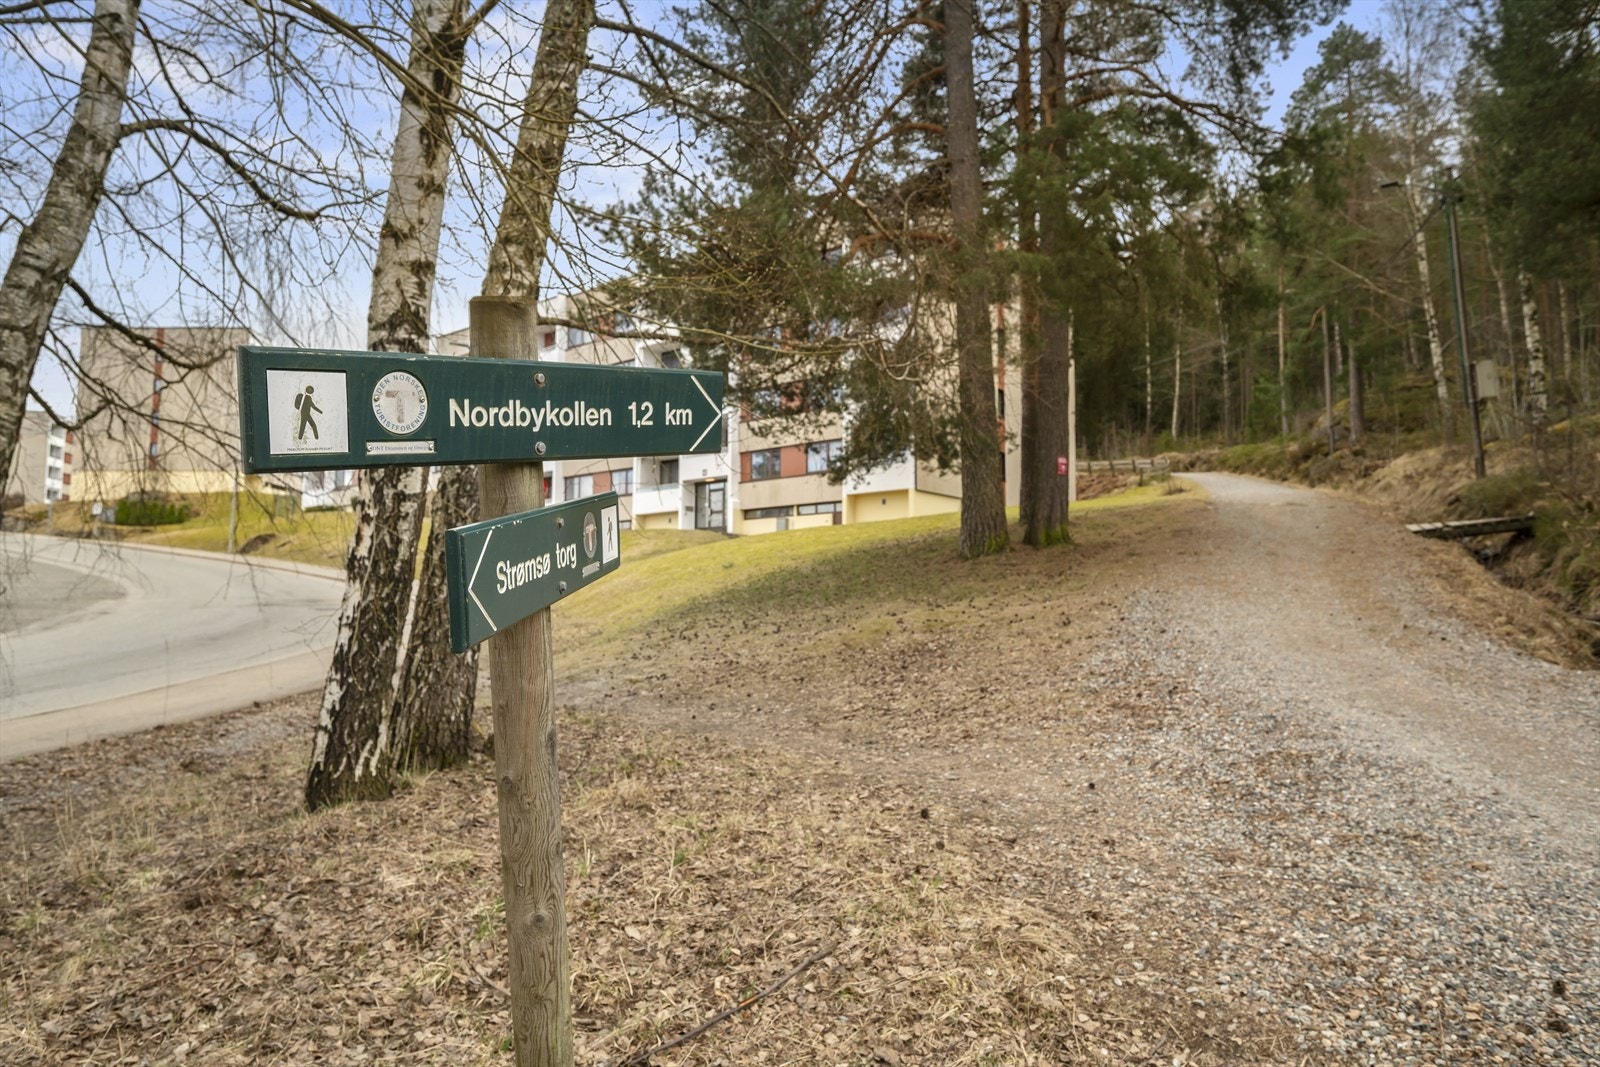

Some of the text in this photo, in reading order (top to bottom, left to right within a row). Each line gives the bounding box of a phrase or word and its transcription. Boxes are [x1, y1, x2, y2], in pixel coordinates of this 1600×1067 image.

[376, 374, 423, 396] DEN NORSKE
[374, 404, 426, 432] TURISTFORENING
[449, 398, 693, 432] Nordbykollen 1,2 km
[497, 543, 577, 594] Strømsø torg
